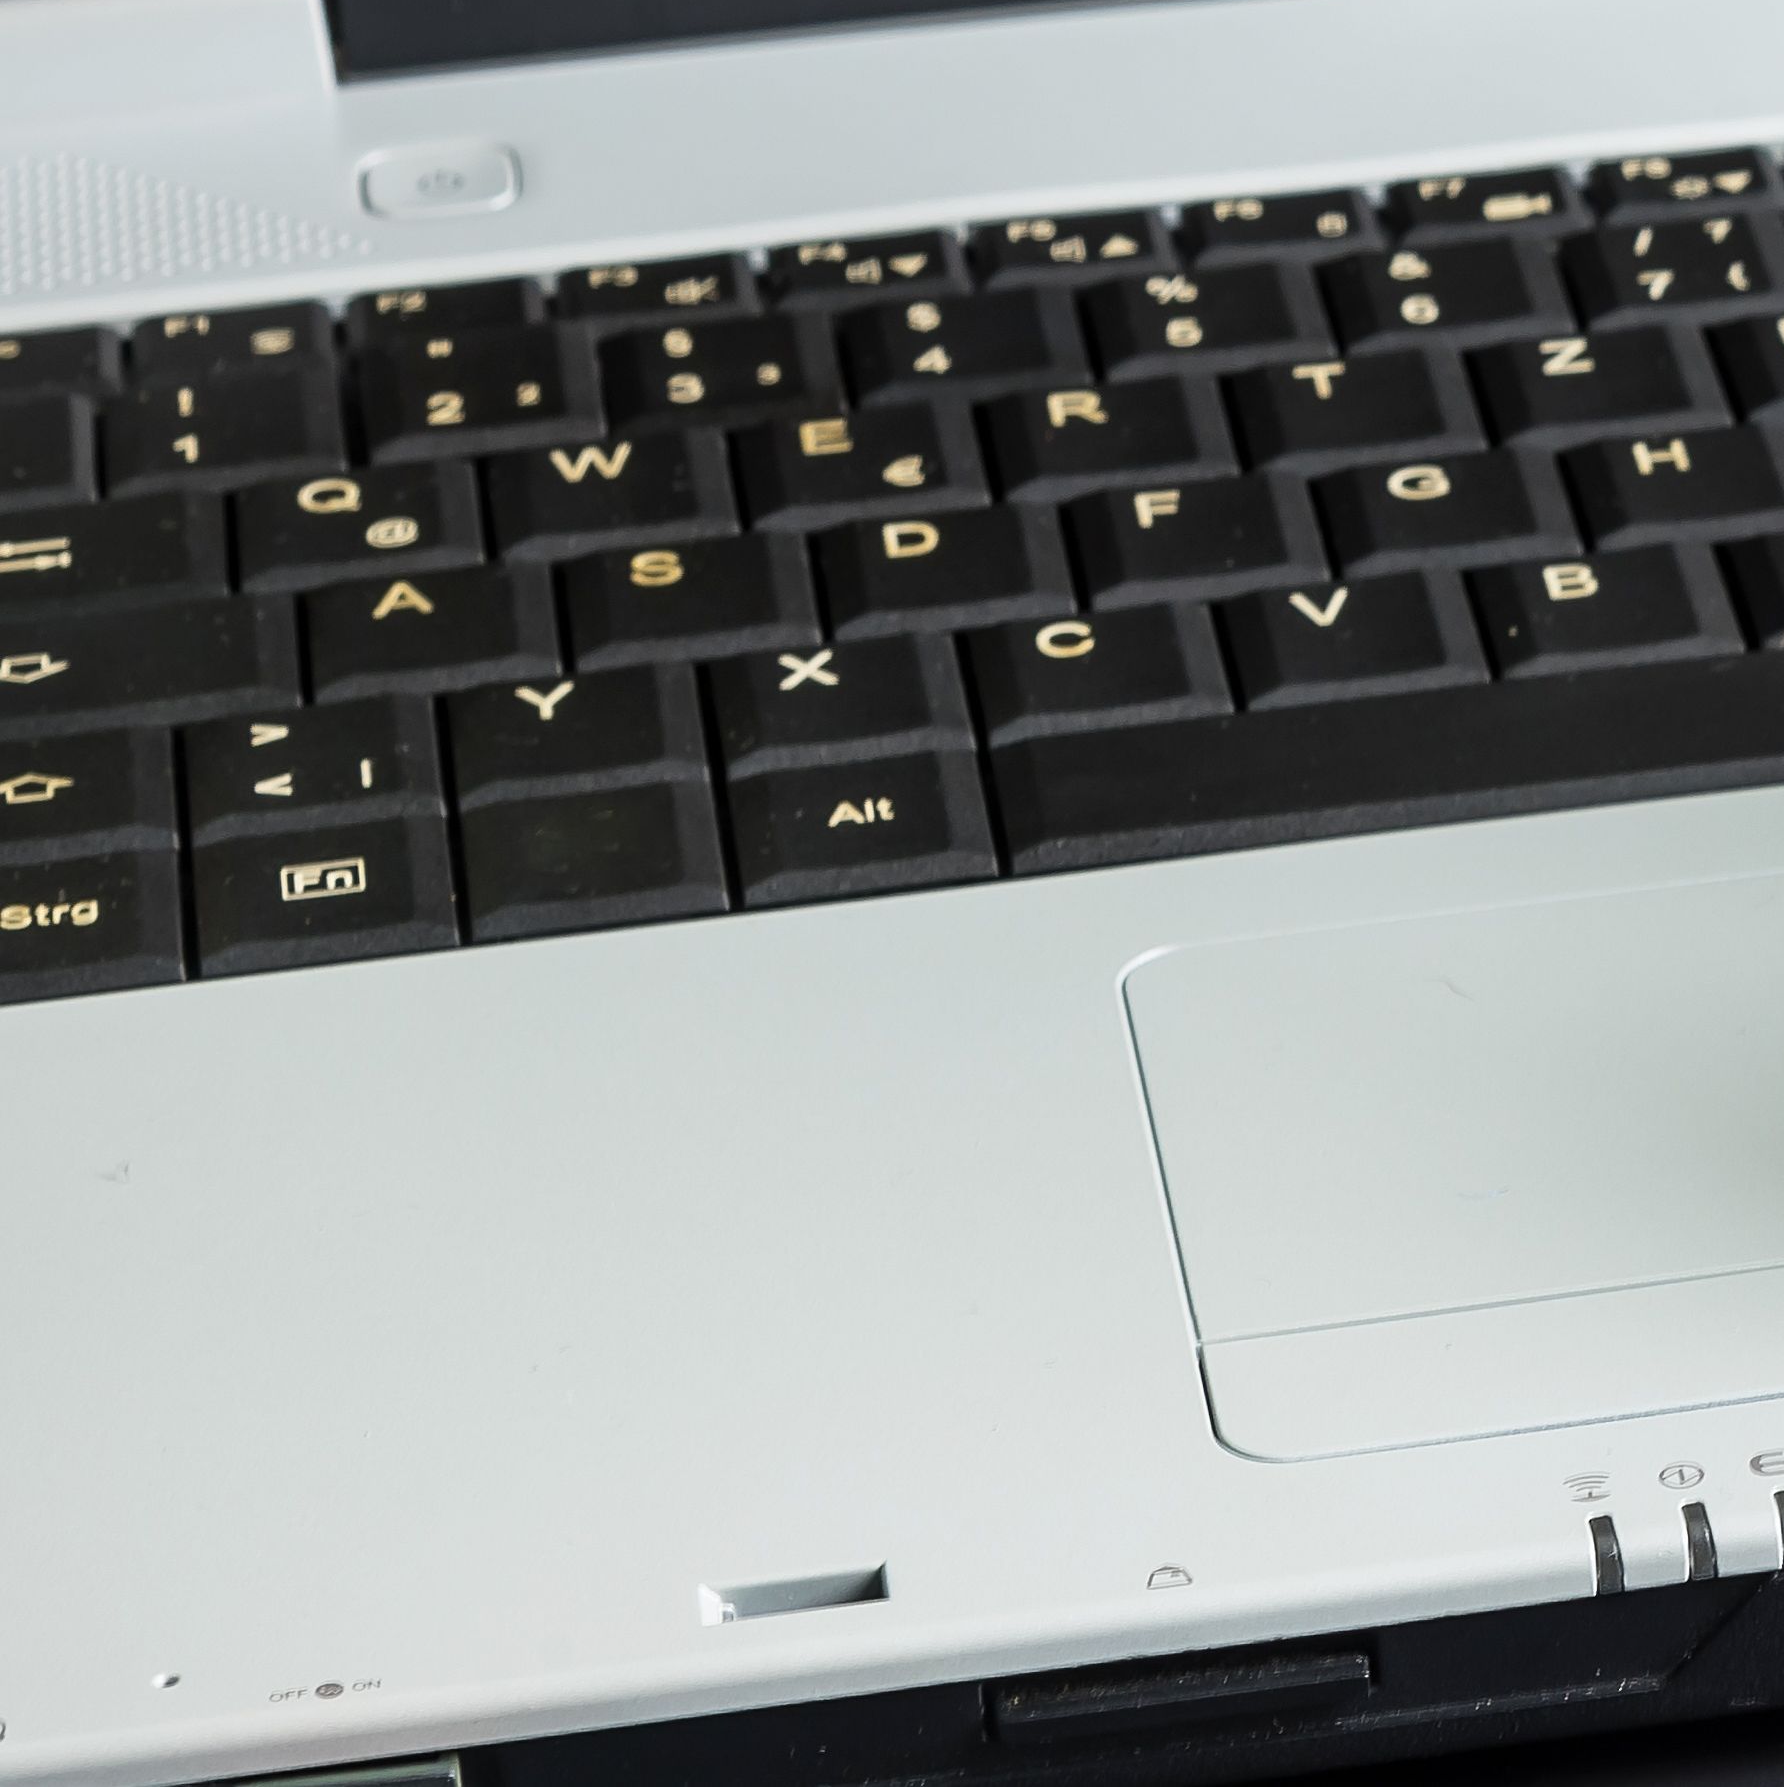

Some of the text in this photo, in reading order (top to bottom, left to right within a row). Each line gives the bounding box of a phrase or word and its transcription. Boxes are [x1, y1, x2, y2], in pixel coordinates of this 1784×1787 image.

[1539, 338, 1594, 376] Z
[1292, 362, 1345, 399] T
[427, 392, 464, 425] 2
[1046, 391, 1106, 427] R
[173, 434, 199, 463] 1
[799, 418, 851, 456] E
[550, 442, 632, 483] W
[1632, 439, 1690, 475] H
[297, 478, 361, 513] Q
[1387, 465, 1451, 501] G
[1134, 489, 1180, 529] F
[365, 517, 418, 548] @
[882, 521, 939, 559] D
[630, 551, 684, 586] S
[1543, 563, 1599, 600] B
[372, 581, 433, 619] A
[1289, 587, 1348, 627] V
[1035, 621, 1095, 659] C
[778, 649, 839, 691] X
[515, 681, 574, 721] Y
[828, 797, 895, 828] Alt
[294, 868, 353, 895] Fn
[269, 1688, 308, 1703] OFF
[351, 1679, 382, 1692] ON
